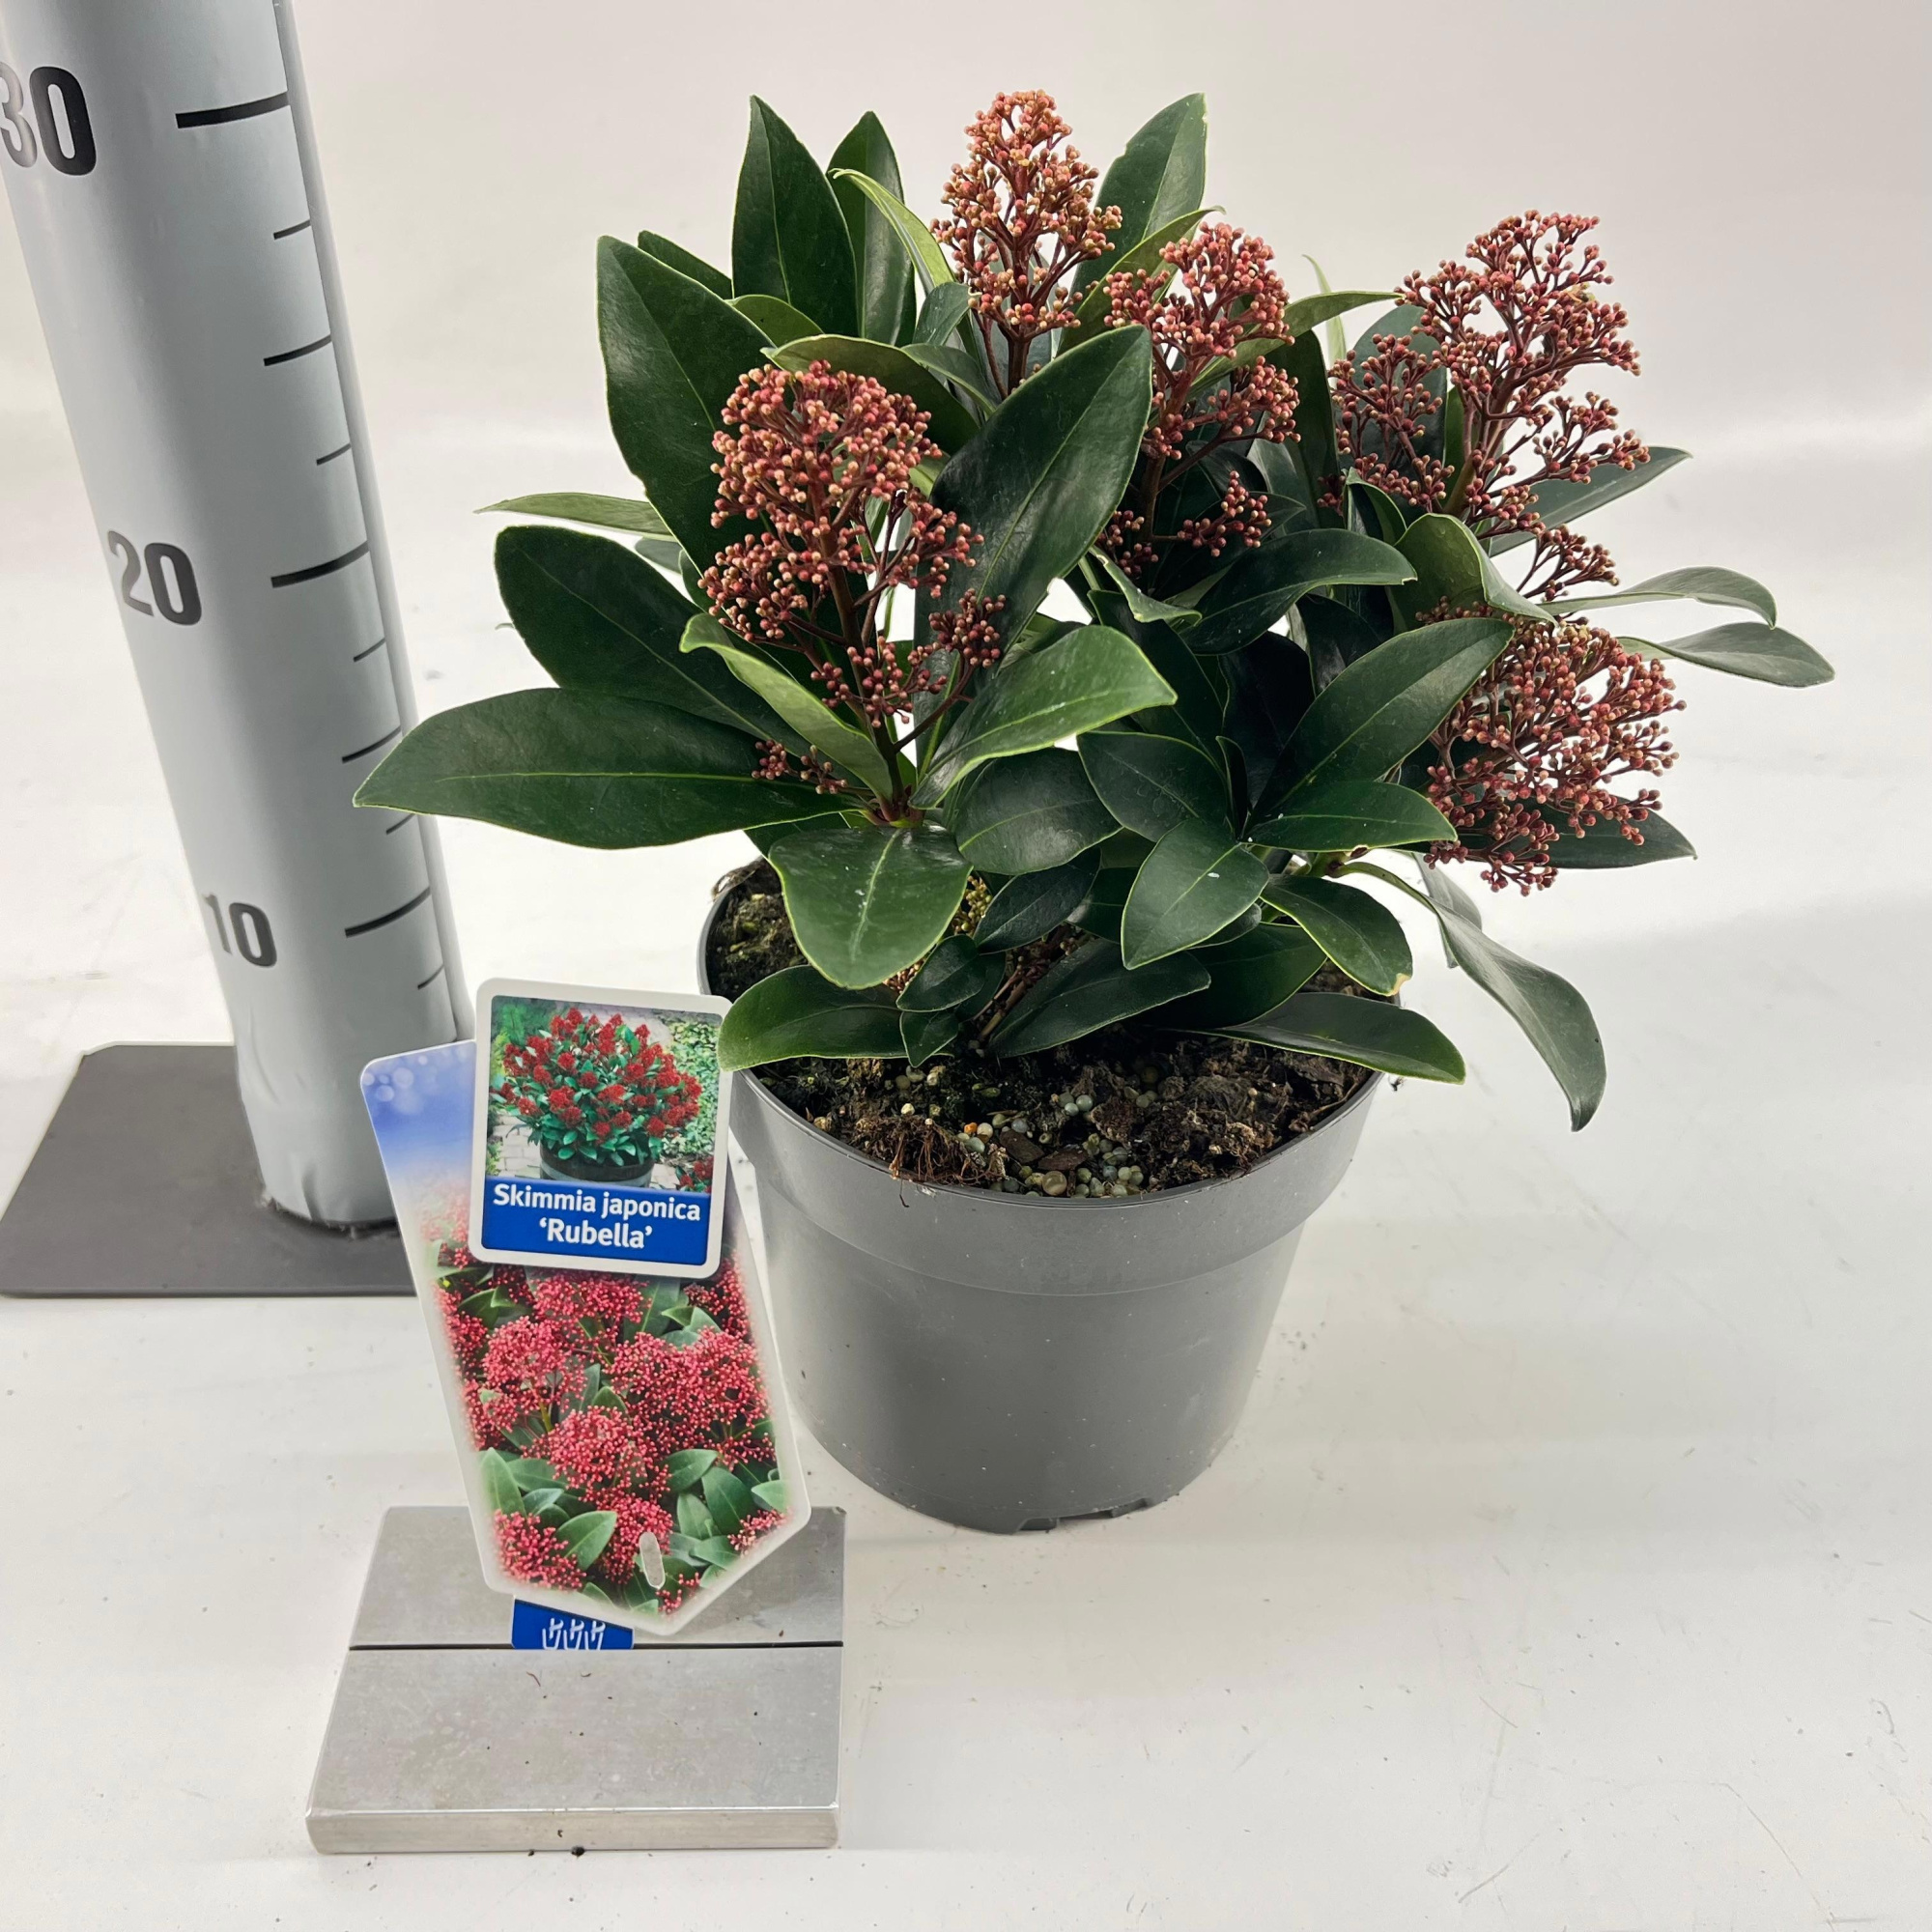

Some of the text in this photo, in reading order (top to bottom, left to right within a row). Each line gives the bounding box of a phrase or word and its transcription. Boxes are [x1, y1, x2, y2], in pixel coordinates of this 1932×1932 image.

[0, 62, 97, 176] 30
[107, 530, 202, 626] 20
[201, 892, 277, 968] 10
[493, 1183, 701, 1221] Skimmia japonica
[539, 1217, 653, 1249] ‘Rubella’
